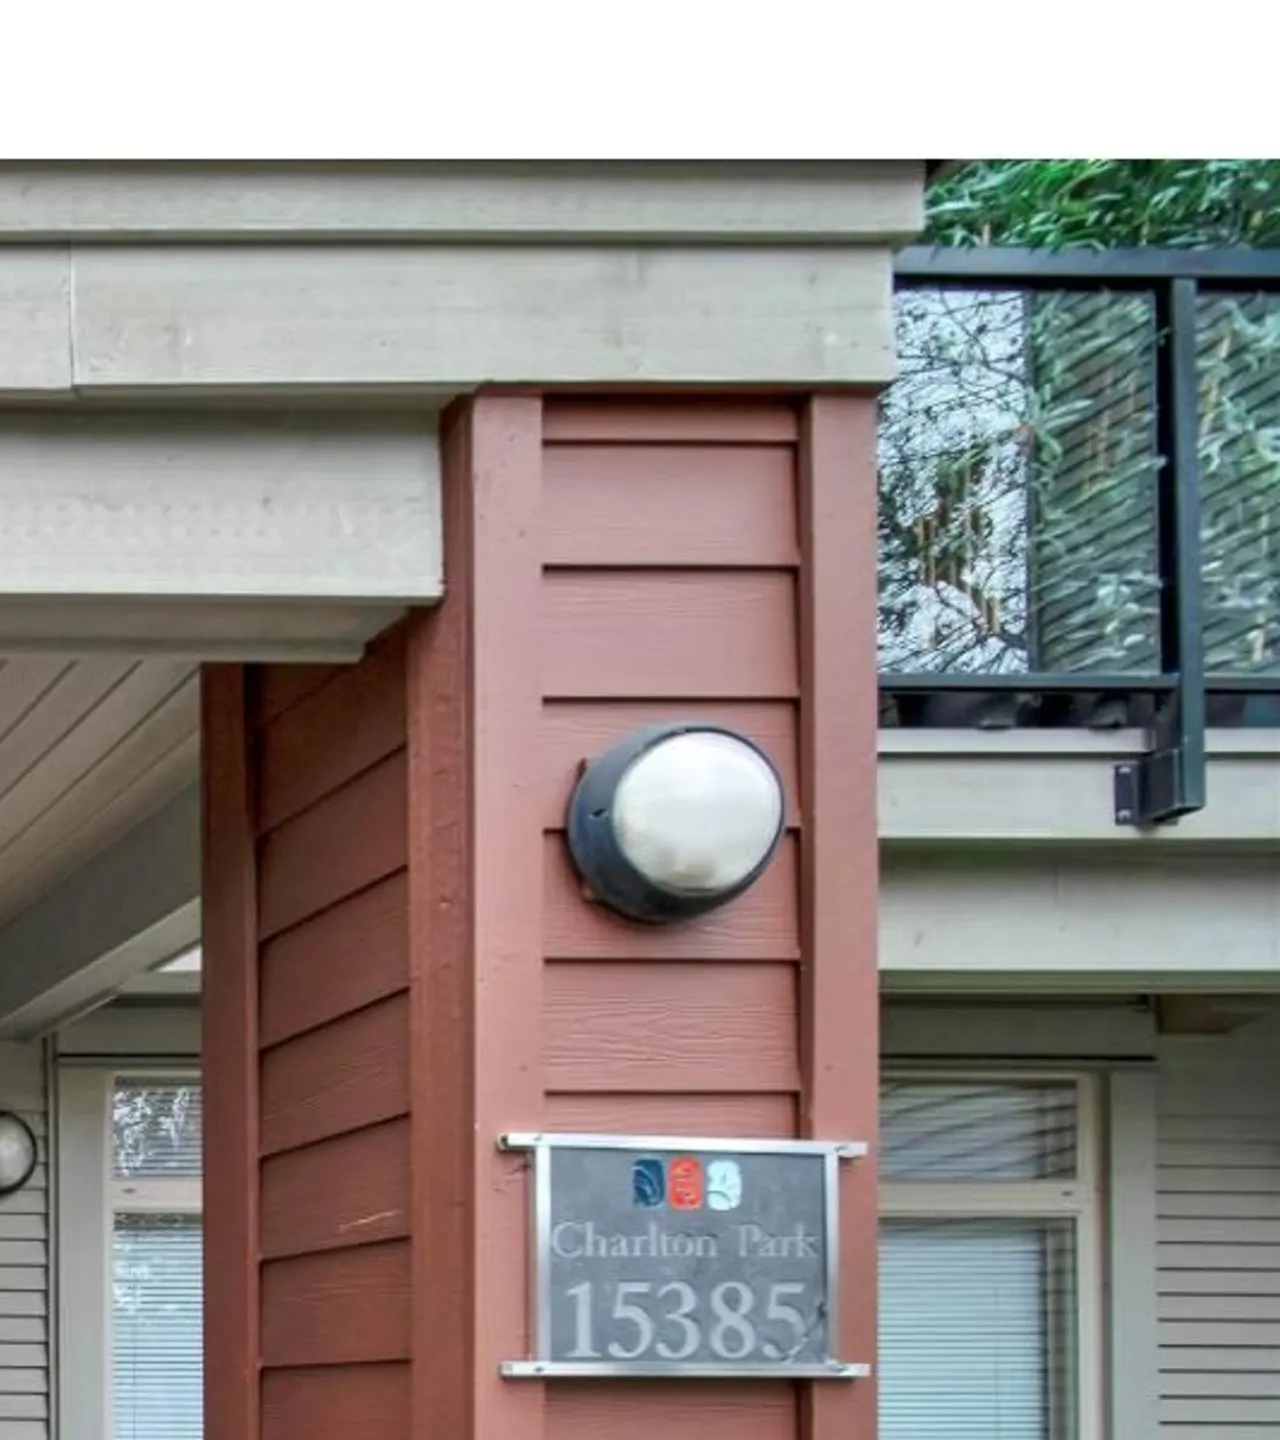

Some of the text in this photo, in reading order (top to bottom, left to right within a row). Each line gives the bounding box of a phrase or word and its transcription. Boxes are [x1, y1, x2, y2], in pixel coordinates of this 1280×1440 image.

[551, 1220, 821, 1258] Charlton Park
[564, 1281, 808, 1359] 15385
